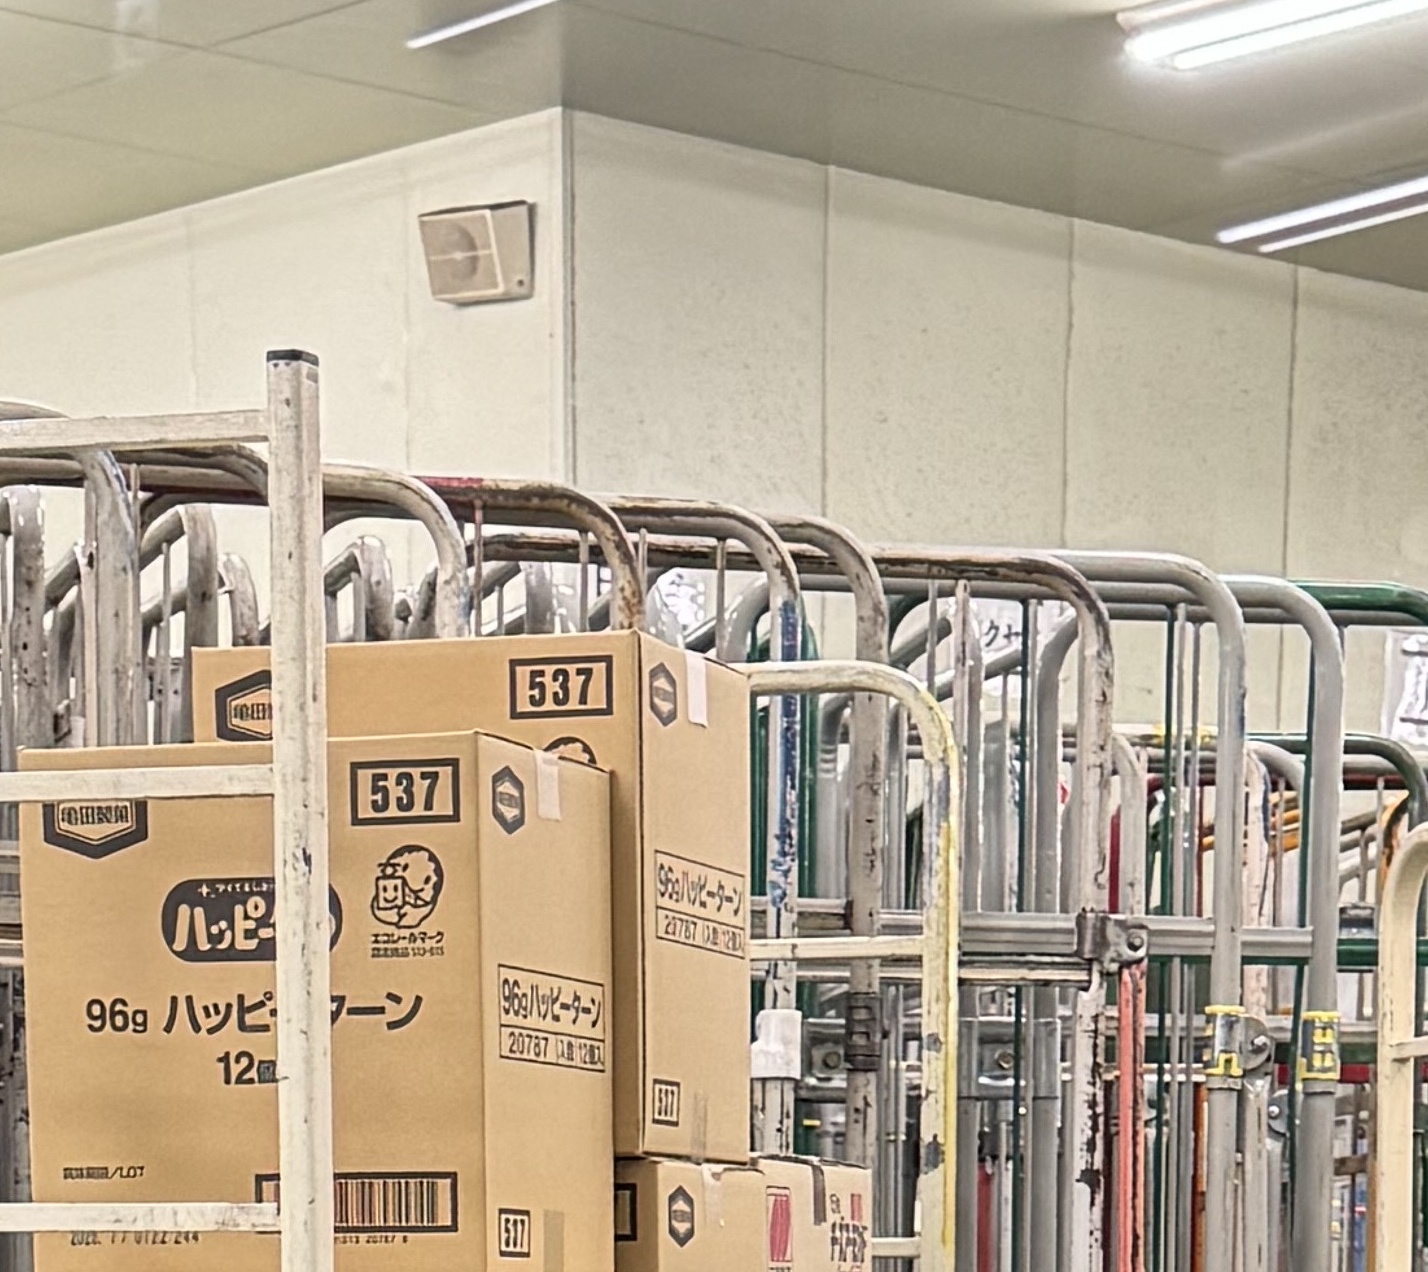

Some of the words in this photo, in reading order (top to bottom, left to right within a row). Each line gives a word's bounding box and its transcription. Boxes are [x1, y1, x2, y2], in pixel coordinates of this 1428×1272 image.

[528, 667, 594, 708] 537
[370, 771, 440, 813] 537
[86, 998, 148, 1034] 96g
[502, 977, 601, 1028] 96gハッピーターン
[508, 1031, 549, 1059] 20787
